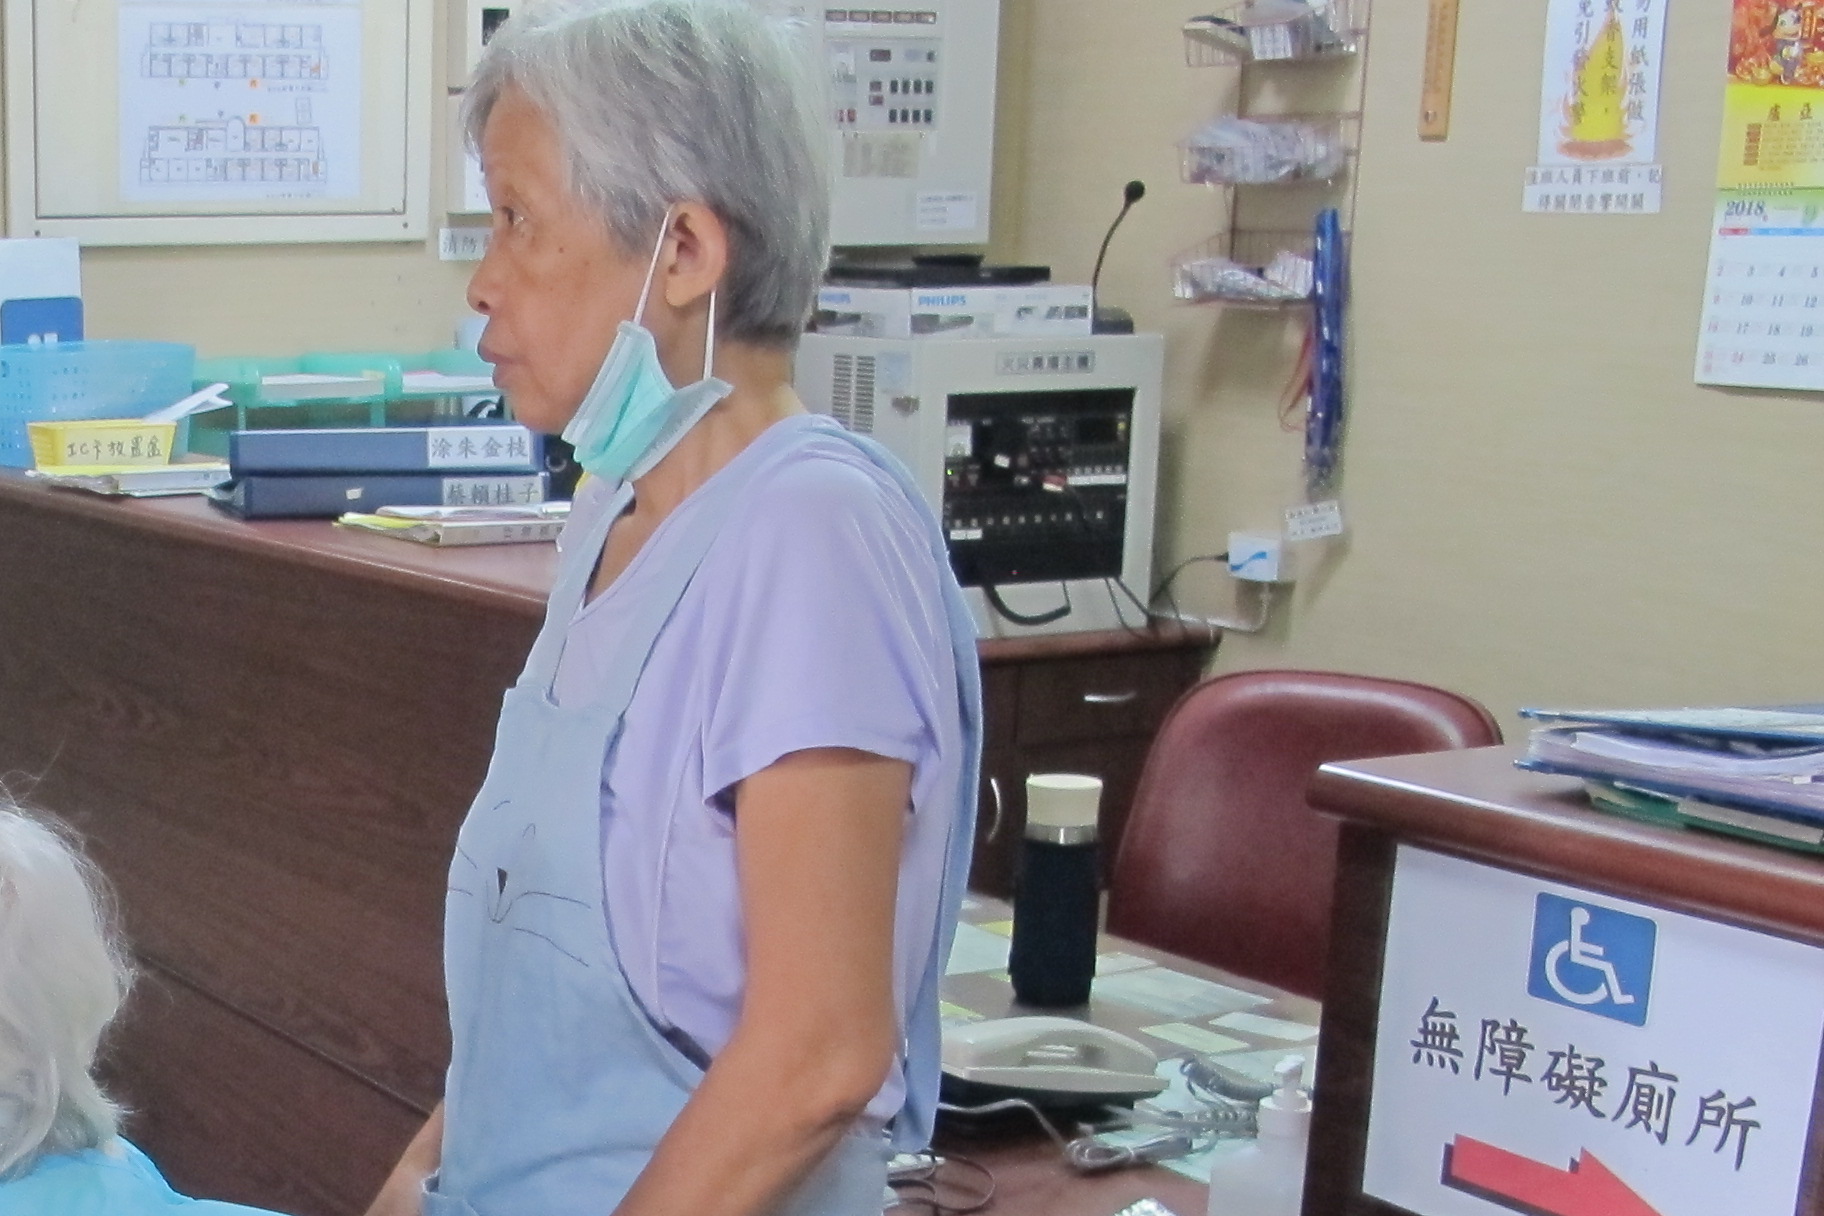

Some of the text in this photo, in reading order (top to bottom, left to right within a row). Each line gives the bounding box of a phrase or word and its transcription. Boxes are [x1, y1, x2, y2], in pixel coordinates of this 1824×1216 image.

[1726, 200, 1765, 217] 2018
[918, 295, 966, 305] PHILIPS
[431, 436, 529, 459] 涂朱金枝
[1409, 996, 1762, 1172] 無障礙廁所
